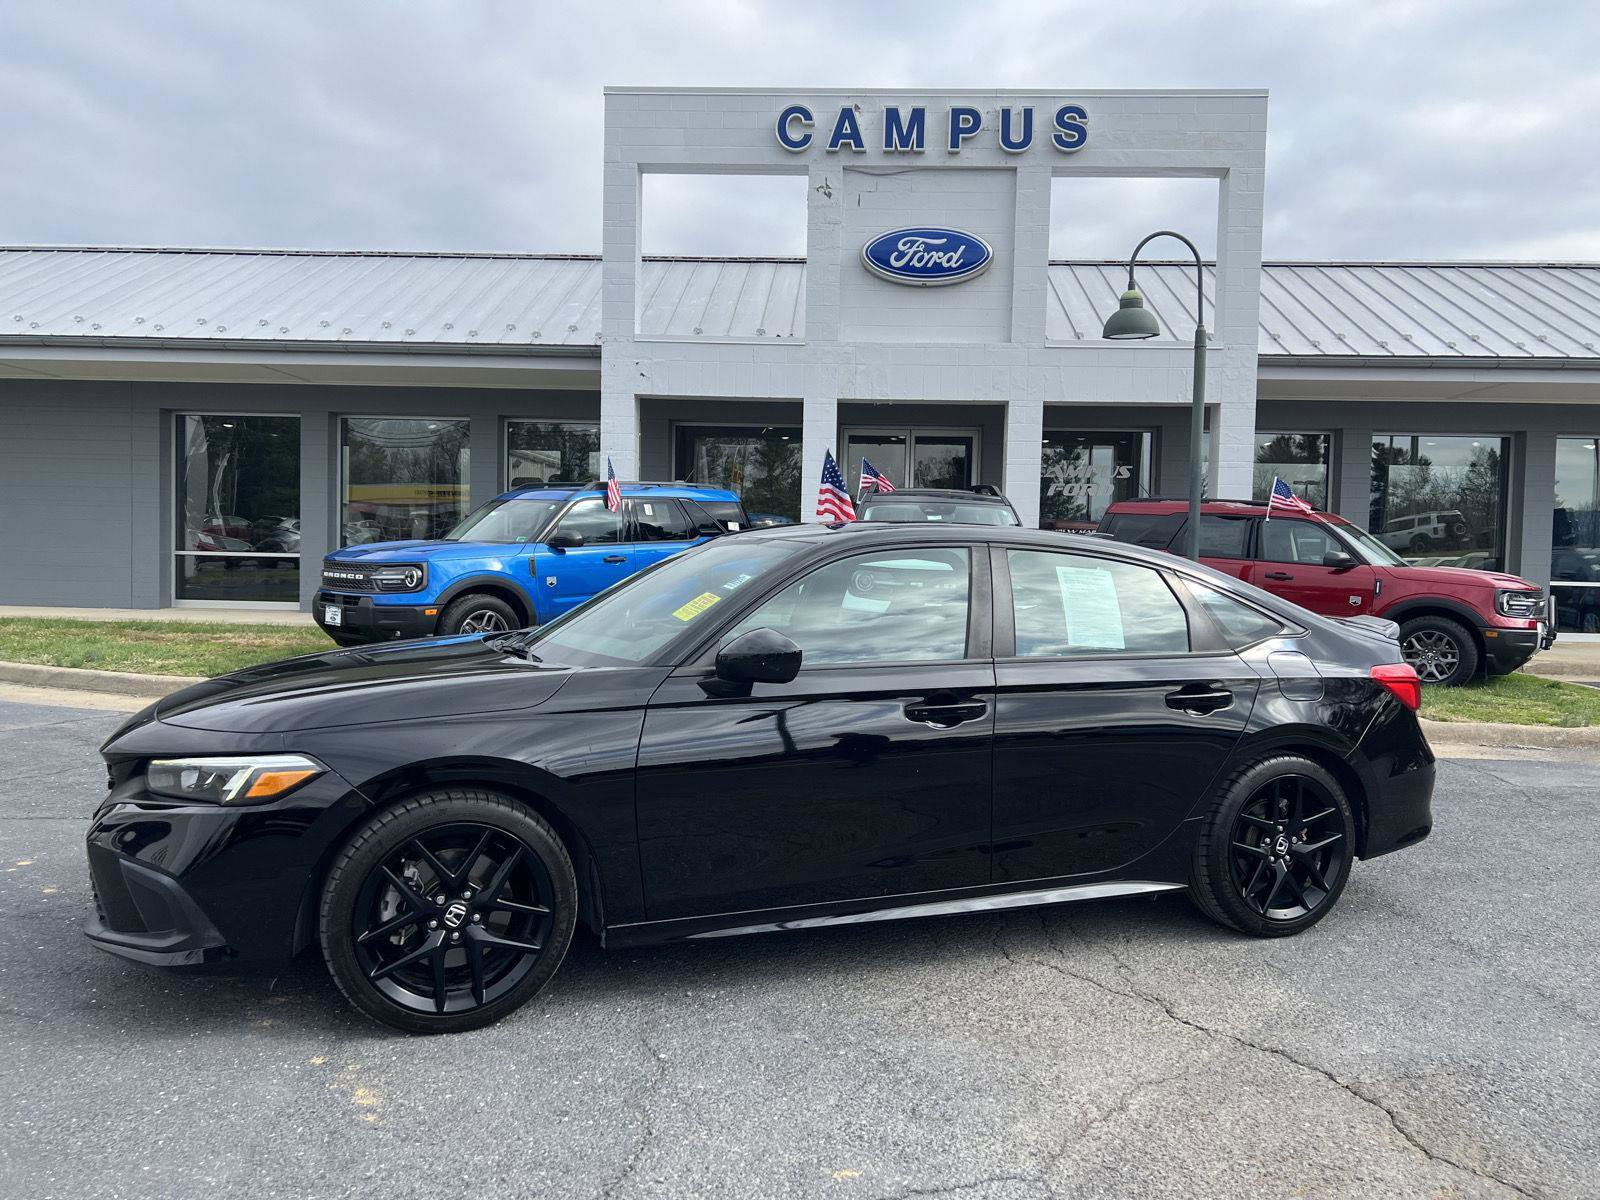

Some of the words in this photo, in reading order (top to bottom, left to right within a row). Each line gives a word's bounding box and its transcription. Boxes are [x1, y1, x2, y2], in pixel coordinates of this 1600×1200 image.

[775, 103, 1089, 153] CAMPUS
[890, 237, 966, 268] Ford
[1047, 483, 1115, 497] FORD
[323, 571, 364, 580] BRONCO
